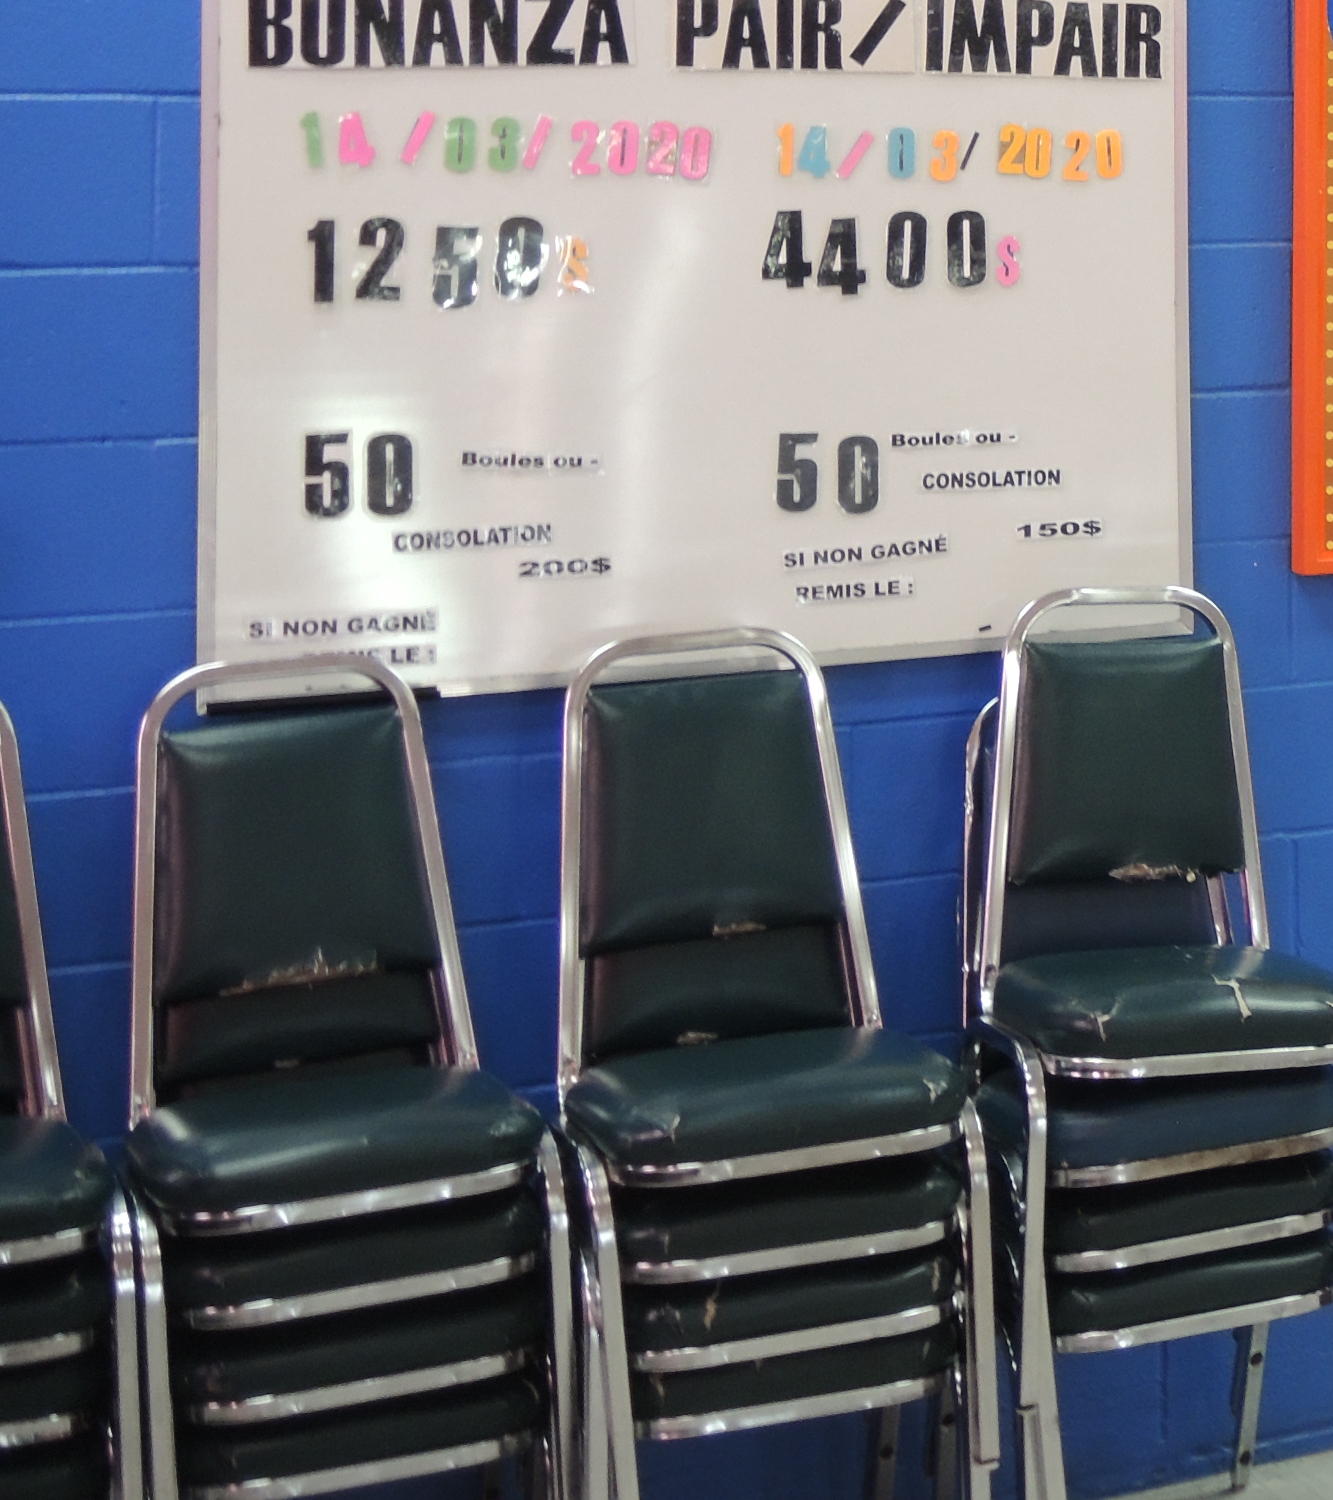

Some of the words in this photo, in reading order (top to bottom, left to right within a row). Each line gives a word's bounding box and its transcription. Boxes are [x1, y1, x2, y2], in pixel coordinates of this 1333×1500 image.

[975, 433, 1001, 444] ou
[462, 452, 544, 468] Boules
[553, 456, 582, 467] ou
[303, 431, 414, 518] 50
[776, 431, 879, 514] 50
[922, 468, 1061, 490] CONSOLATION
[393, 523, 552, 552] CONSOLATION
[1017, 520, 1103, 539] 150$
[784, 552, 805, 568] SI
[814, 547, 862, 565] NON
[871, 534, 947, 559] GAGNÉ
[519, 556, 612, 577] 200$
[796, 583, 866, 600] REMIS
[874, 581, 900, 596] LE
[250, 621, 272, 638] SI
[283, 619, 338, 636] NON
[347, 610, 435, 634] GAGNÉ
[391, 646, 419, 663] LE
